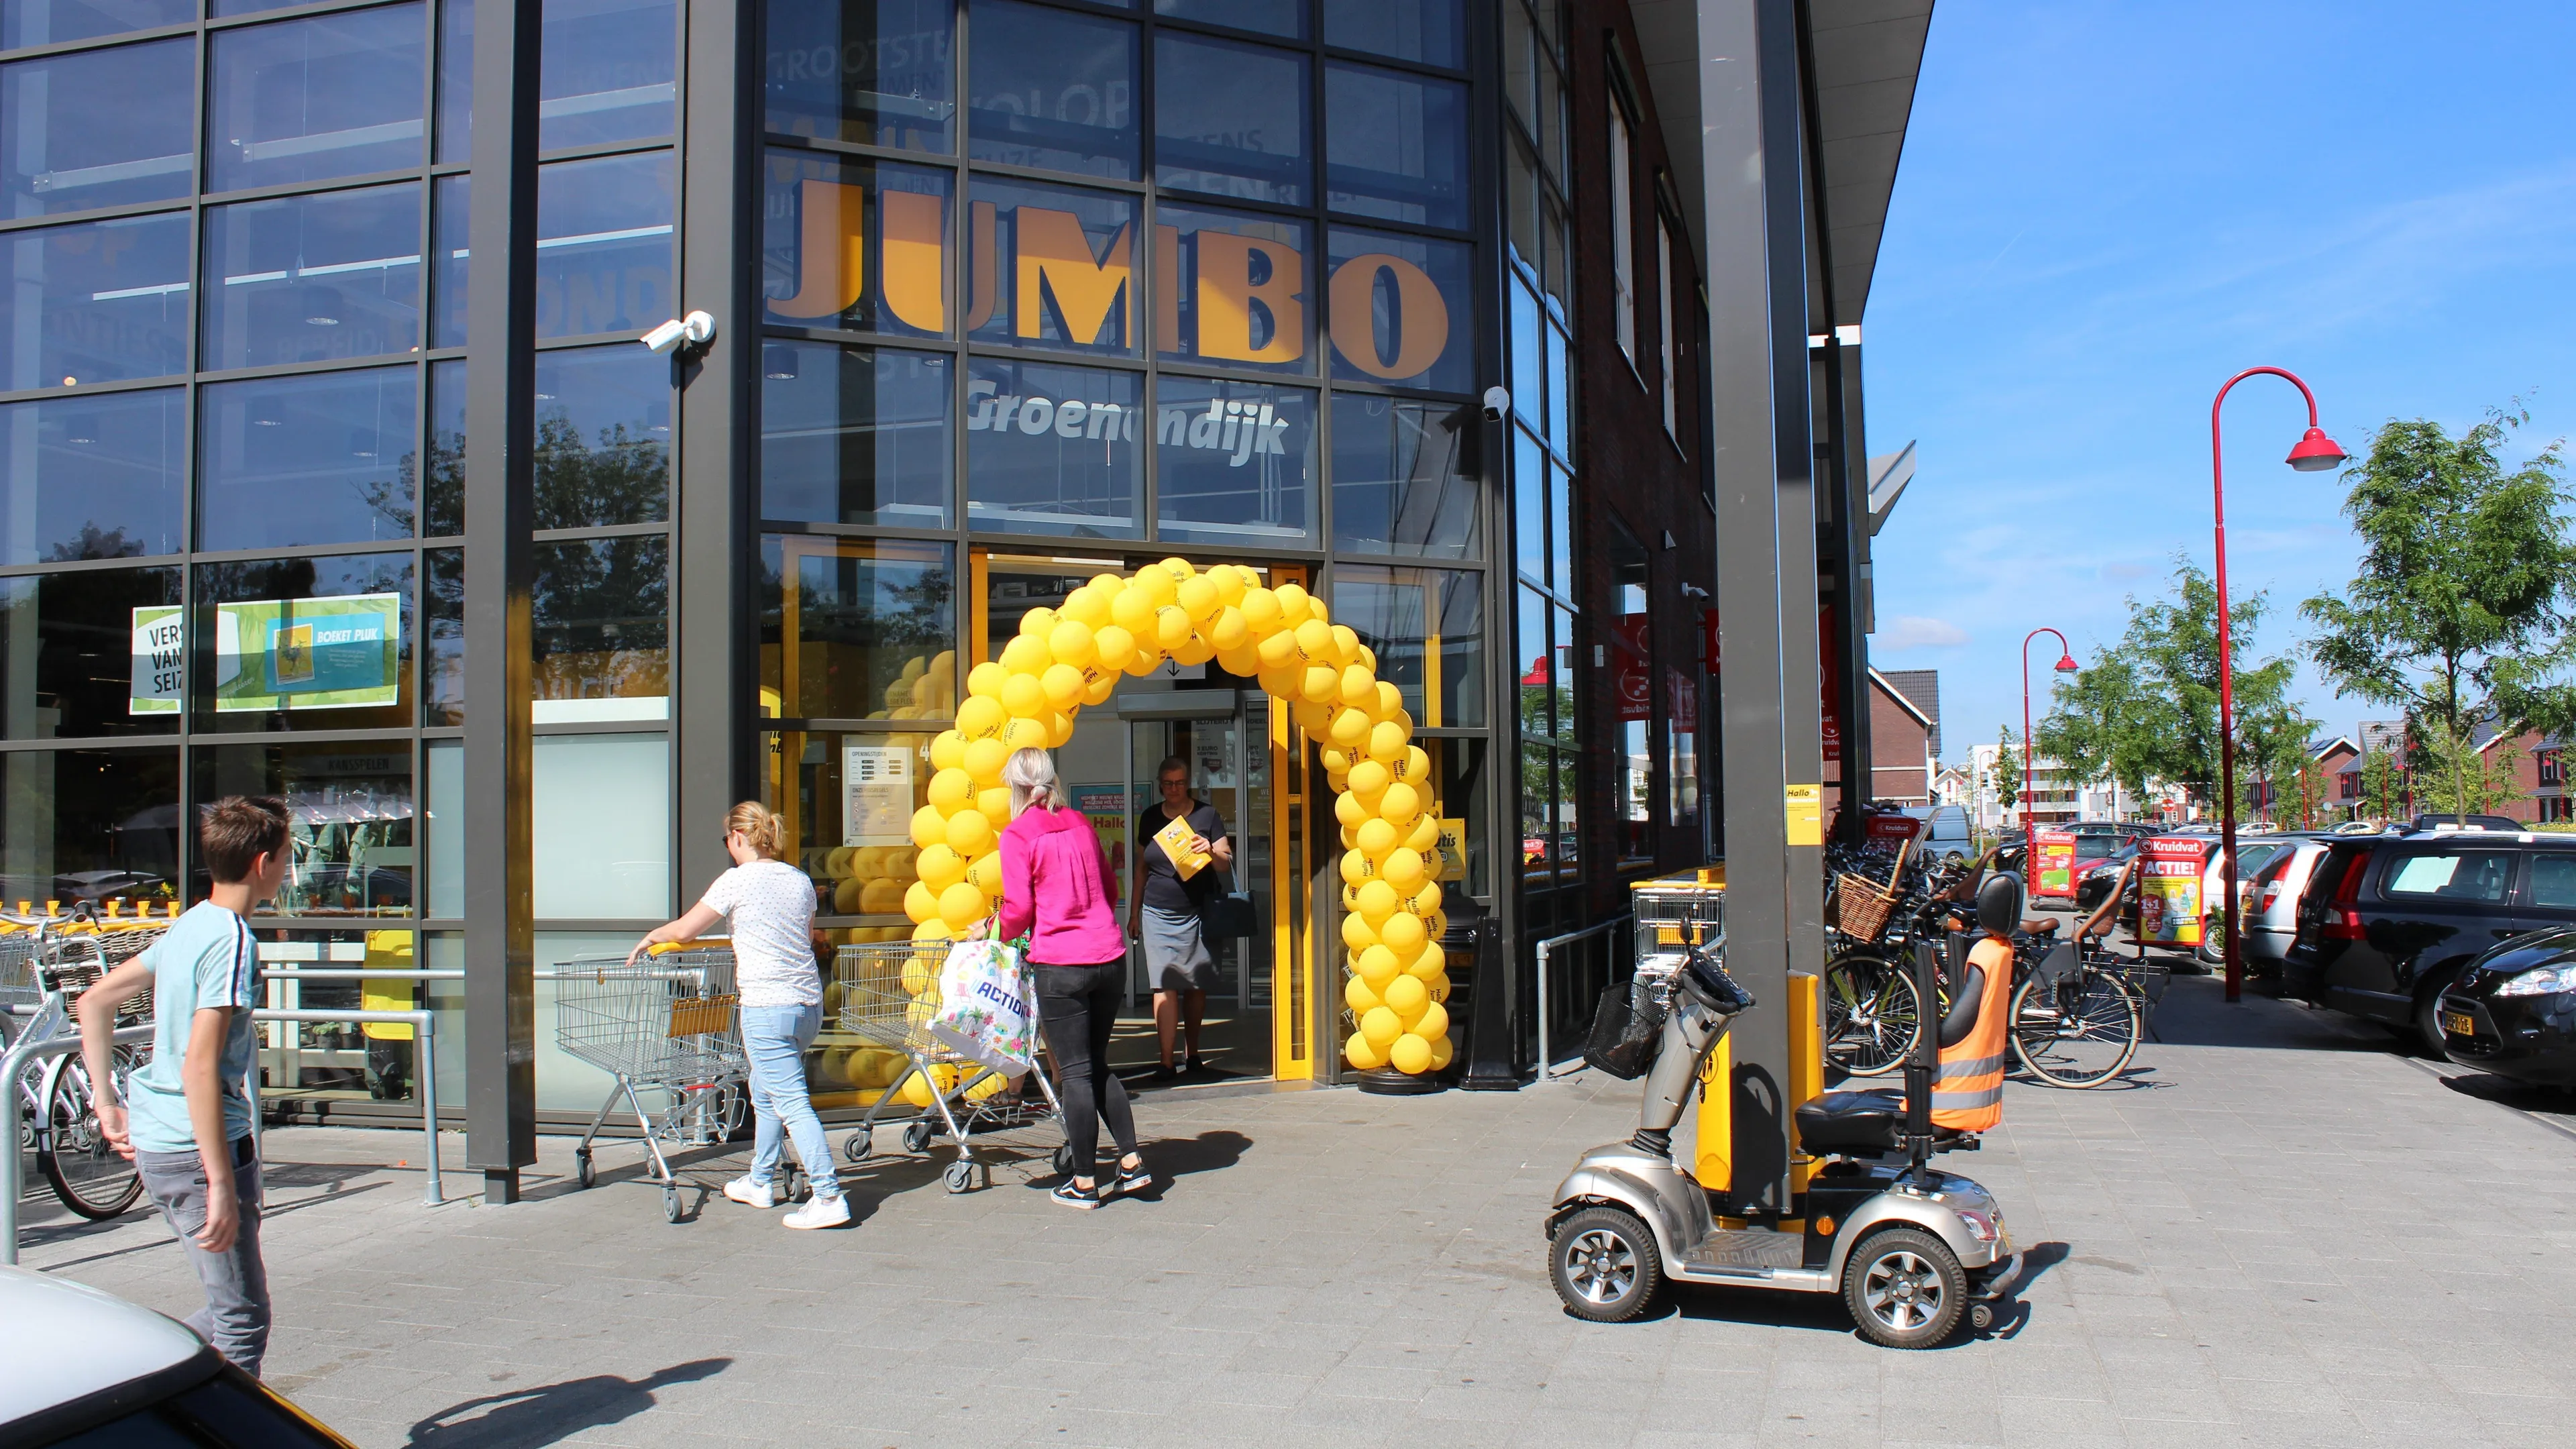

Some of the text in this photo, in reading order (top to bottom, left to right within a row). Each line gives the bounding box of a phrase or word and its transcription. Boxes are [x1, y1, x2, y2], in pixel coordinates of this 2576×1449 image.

[767, 178, 1449, 380] JUMBO
[317, 628, 378, 643] BOEKET PLUK
[977, 724, 994, 739] Hallo
[919, 737, 930, 761] 4
[329, 758, 389, 771] KANSSPELEN
[2153, 841, 2199, 853] Kruidvat
[2144, 861, 2196, 875] ACTIE!
[1411, 896, 1420, 915] Hallo
[2141, 899, 2159, 910] 1+1
[1424, 917, 1433, 938] Jumbo!
[977, 981, 1026, 1022] ACTION
